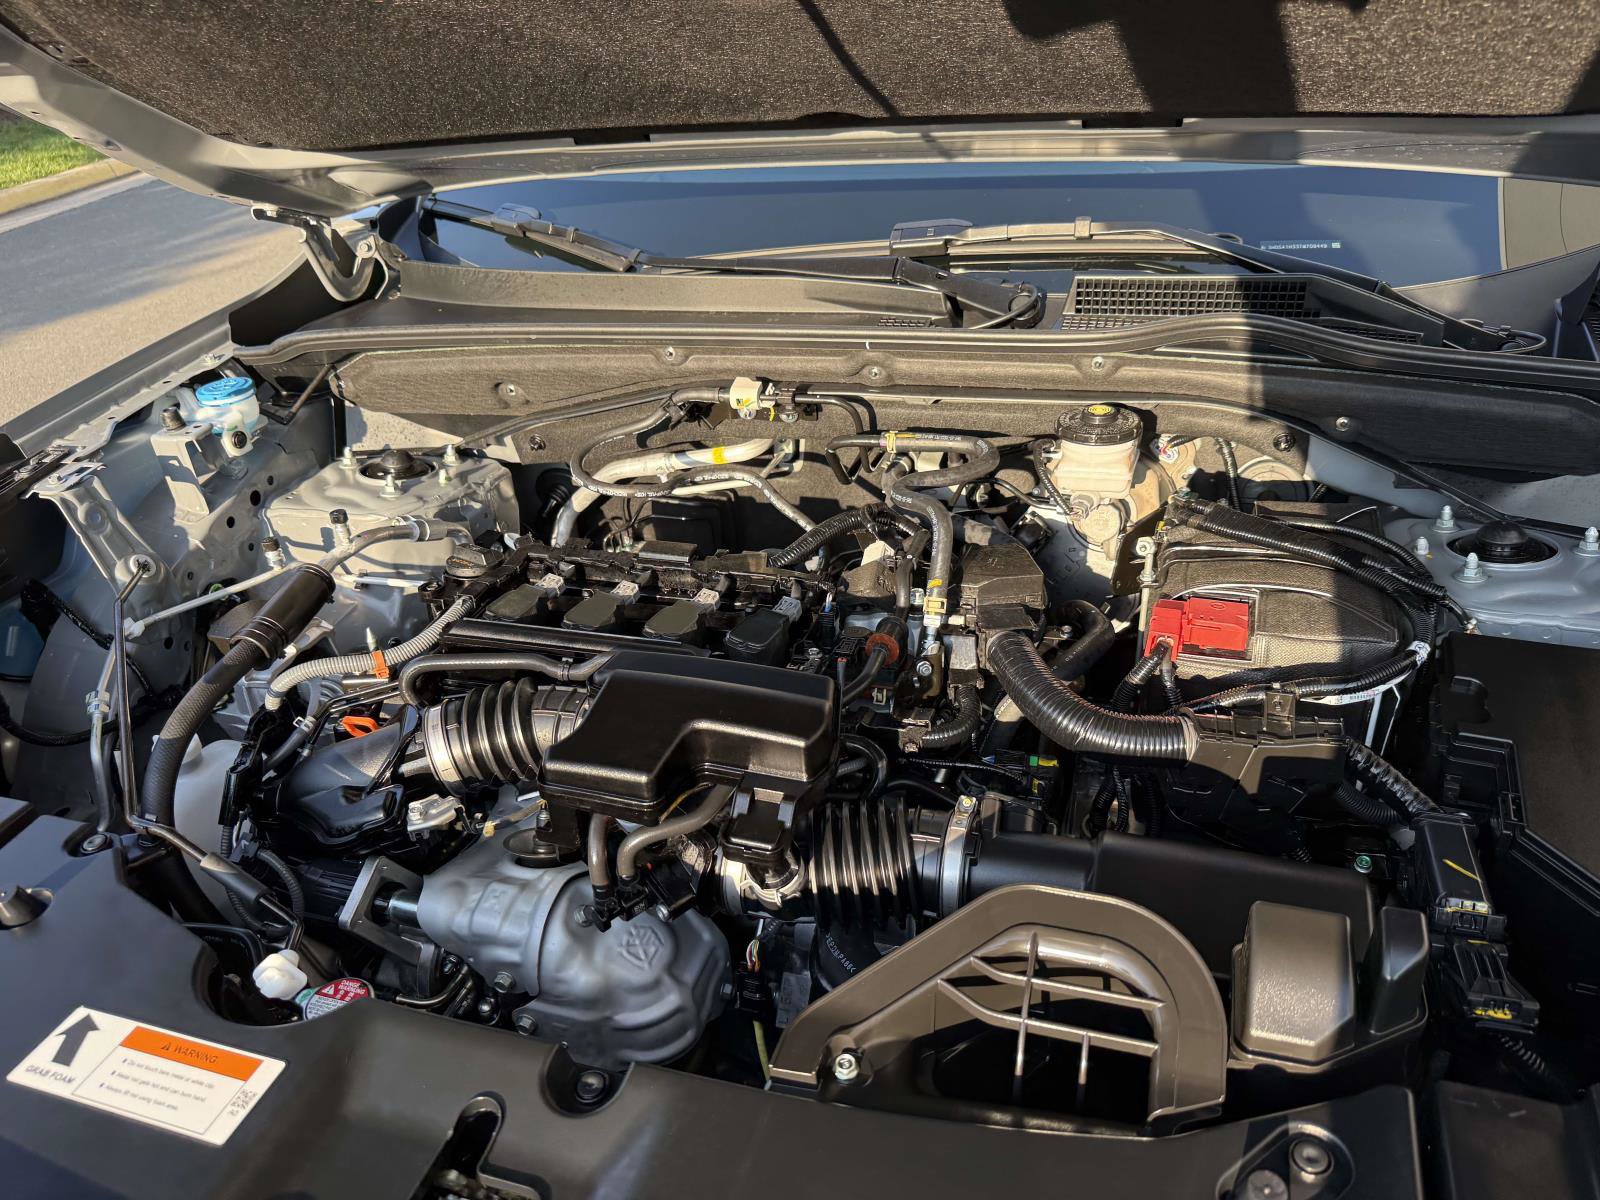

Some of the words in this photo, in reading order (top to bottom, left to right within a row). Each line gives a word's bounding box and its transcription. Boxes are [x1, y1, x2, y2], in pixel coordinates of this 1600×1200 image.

[174, 1045, 218, 1063] WARNING
[25, 1064, 50, 1077] GRAB
[49, 1071, 76, 1084] FOAM
